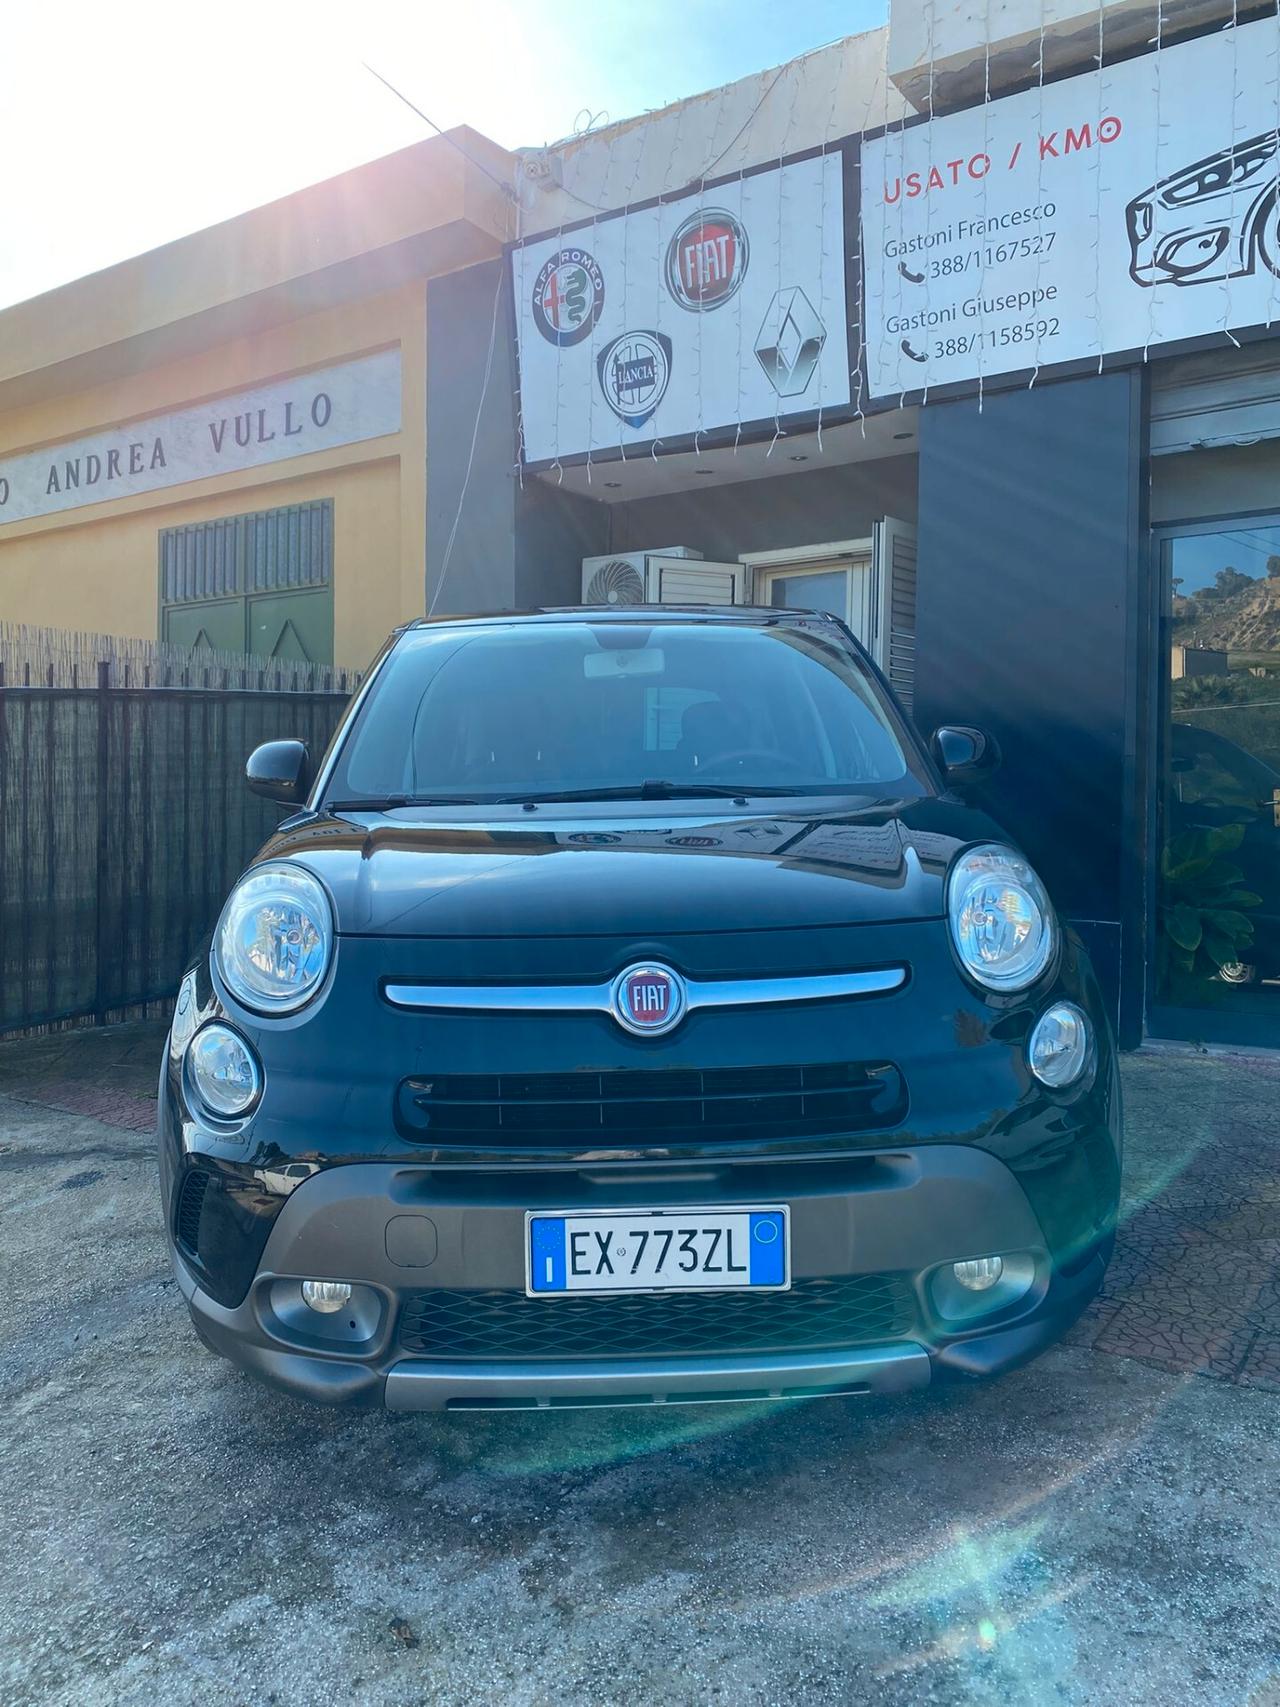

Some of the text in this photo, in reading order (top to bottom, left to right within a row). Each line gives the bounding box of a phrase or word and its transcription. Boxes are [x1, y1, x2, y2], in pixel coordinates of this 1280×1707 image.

[884, 153, 991, 204] USATO
[884, 203, 1056, 257] Gastoni Francesco
[534, 251, 603, 306] ALFA ROMEO
[684, 234, 729, 289] FIAT
[930, 232, 1057, 279] 388/1167527
[886, 285, 1058, 334] Gastoni Giuseppe
[934, 318, 1060, 359] 388/1158592
[618, 365, 654, 384] LANCIA
[46, 437, 167, 495] ANDREA
[208, 392, 332, 454] VULLO
[633, 984, 667, 1012] FIAT
